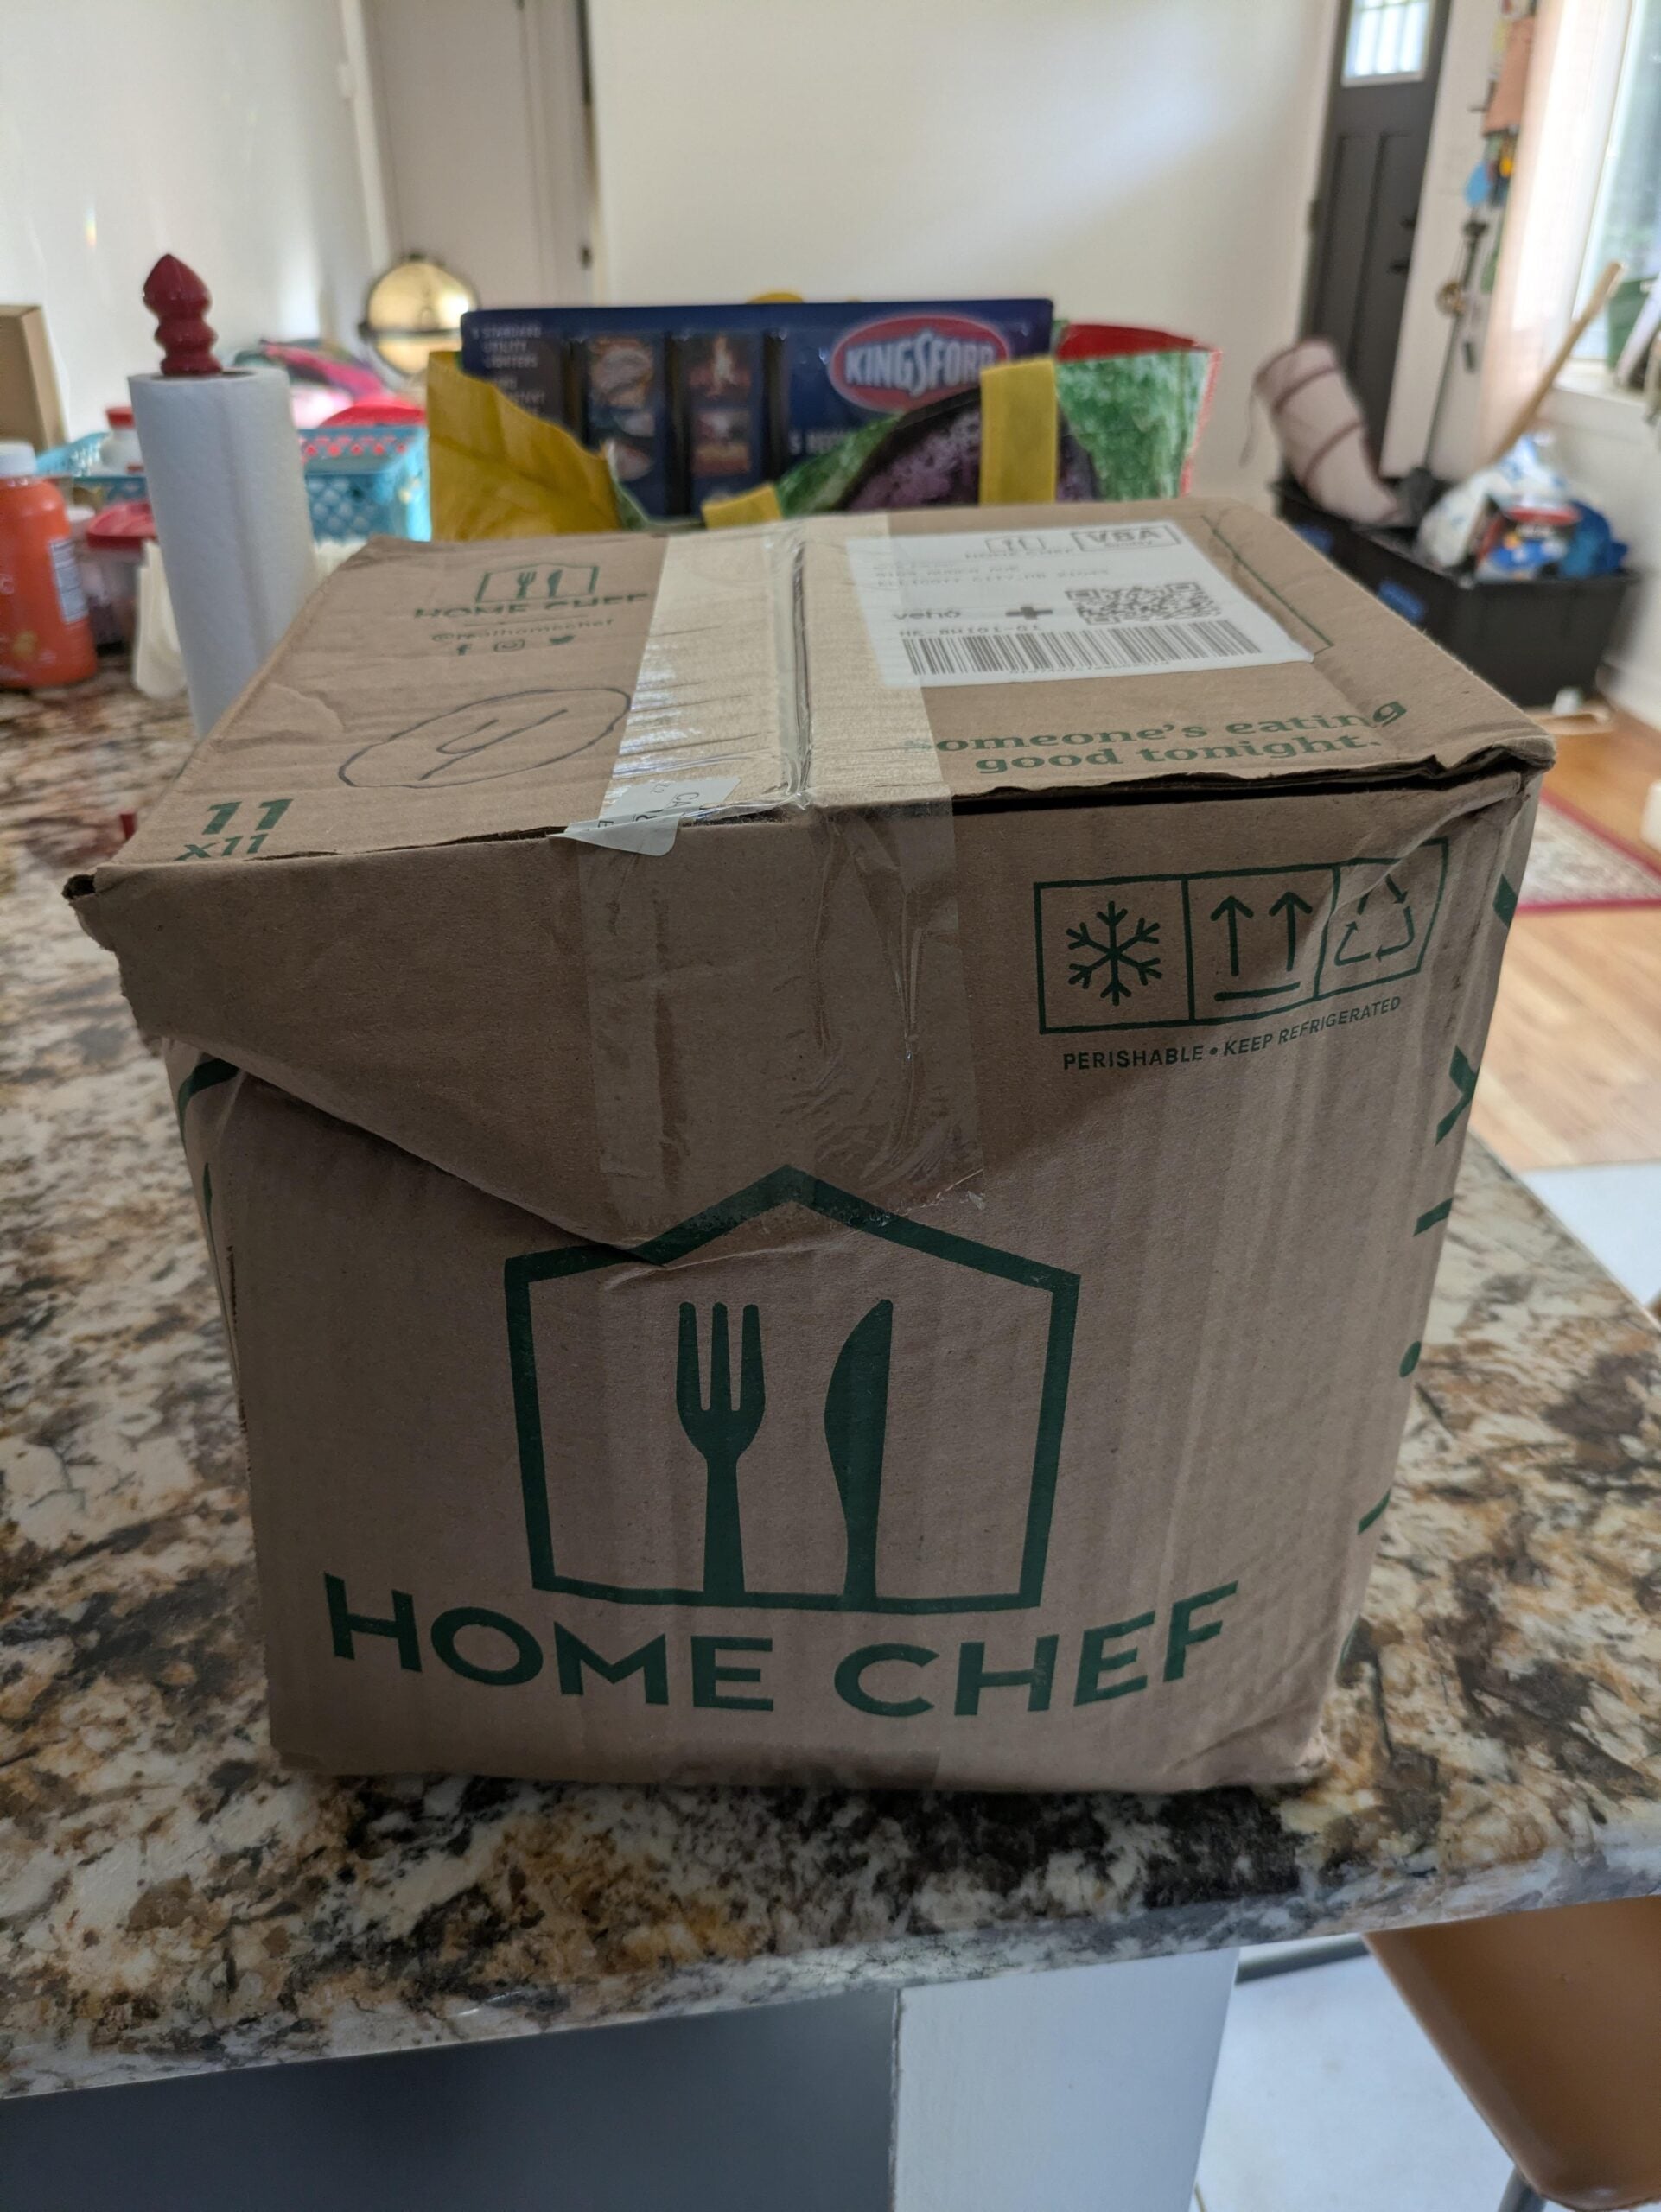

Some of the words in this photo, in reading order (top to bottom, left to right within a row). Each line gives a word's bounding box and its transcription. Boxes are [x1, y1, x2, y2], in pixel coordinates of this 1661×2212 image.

[414, 603, 529, 618] HOME
[543, 593, 649, 610] CHEF
[906, 724, 1207, 753] omeone's
[1225, 699, 1408, 735] eating
[975, 747, 1124, 775] good
[1135, 731, 1382, 762] tonight.
[201, 798, 294, 836] 11
[173, 833, 270, 861] x11
[1063, 1045, 1204, 1071] PERISHABLE
[1222, 1033, 1275, 1057] KEEP
[1277, 995, 1402, 1045] REFRIGERATED
[323, 1572, 775, 1713] HOME
[834, 1579, 1240, 1718] CHEF
